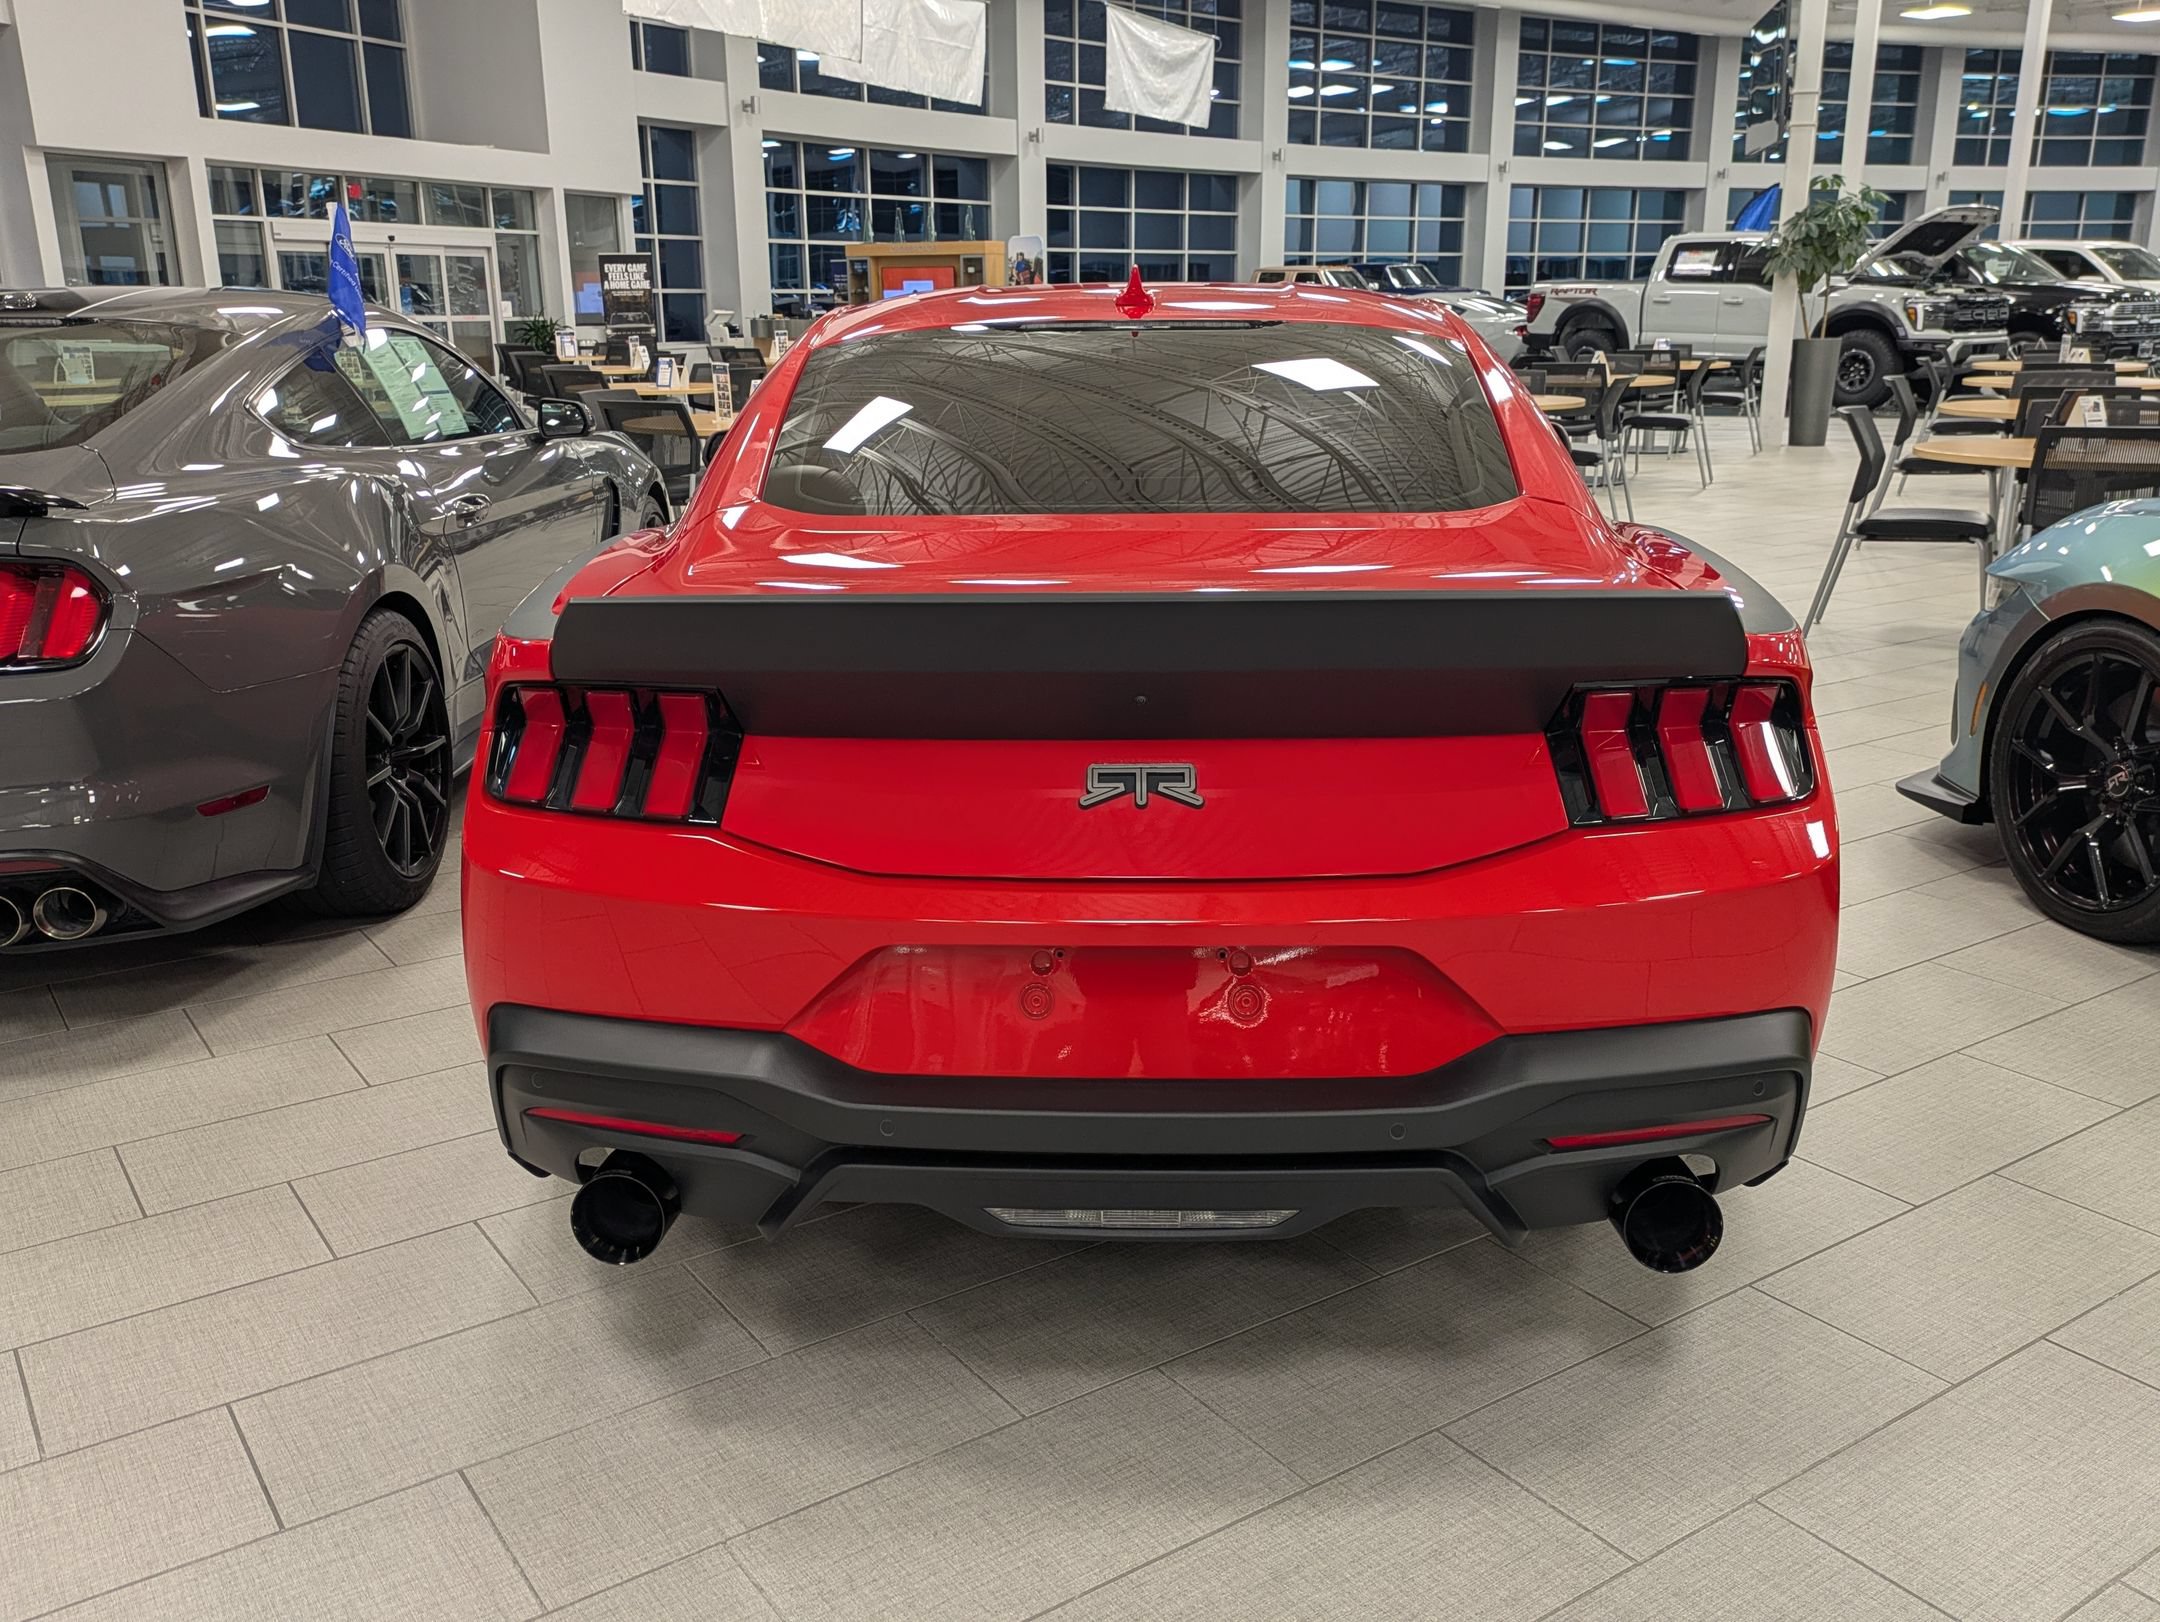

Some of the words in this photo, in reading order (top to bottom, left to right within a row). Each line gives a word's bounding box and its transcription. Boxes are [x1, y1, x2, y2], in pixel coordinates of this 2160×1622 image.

[604, 263, 627, 273] EVERY
[627, 263, 647, 273] GAME
[332, 261, 356, 287] Certified
[608, 272, 629, 281] FEELS
[629, 272, 645, 281] LIKE
[604, 280, 609, 290] A
[610, 280, 630, 289] HOME
[630, 280, 651, 289] GAME
[1551, 287, 1599, 297] RAPTOR
[1079, 762, 1204, 809] RTR
